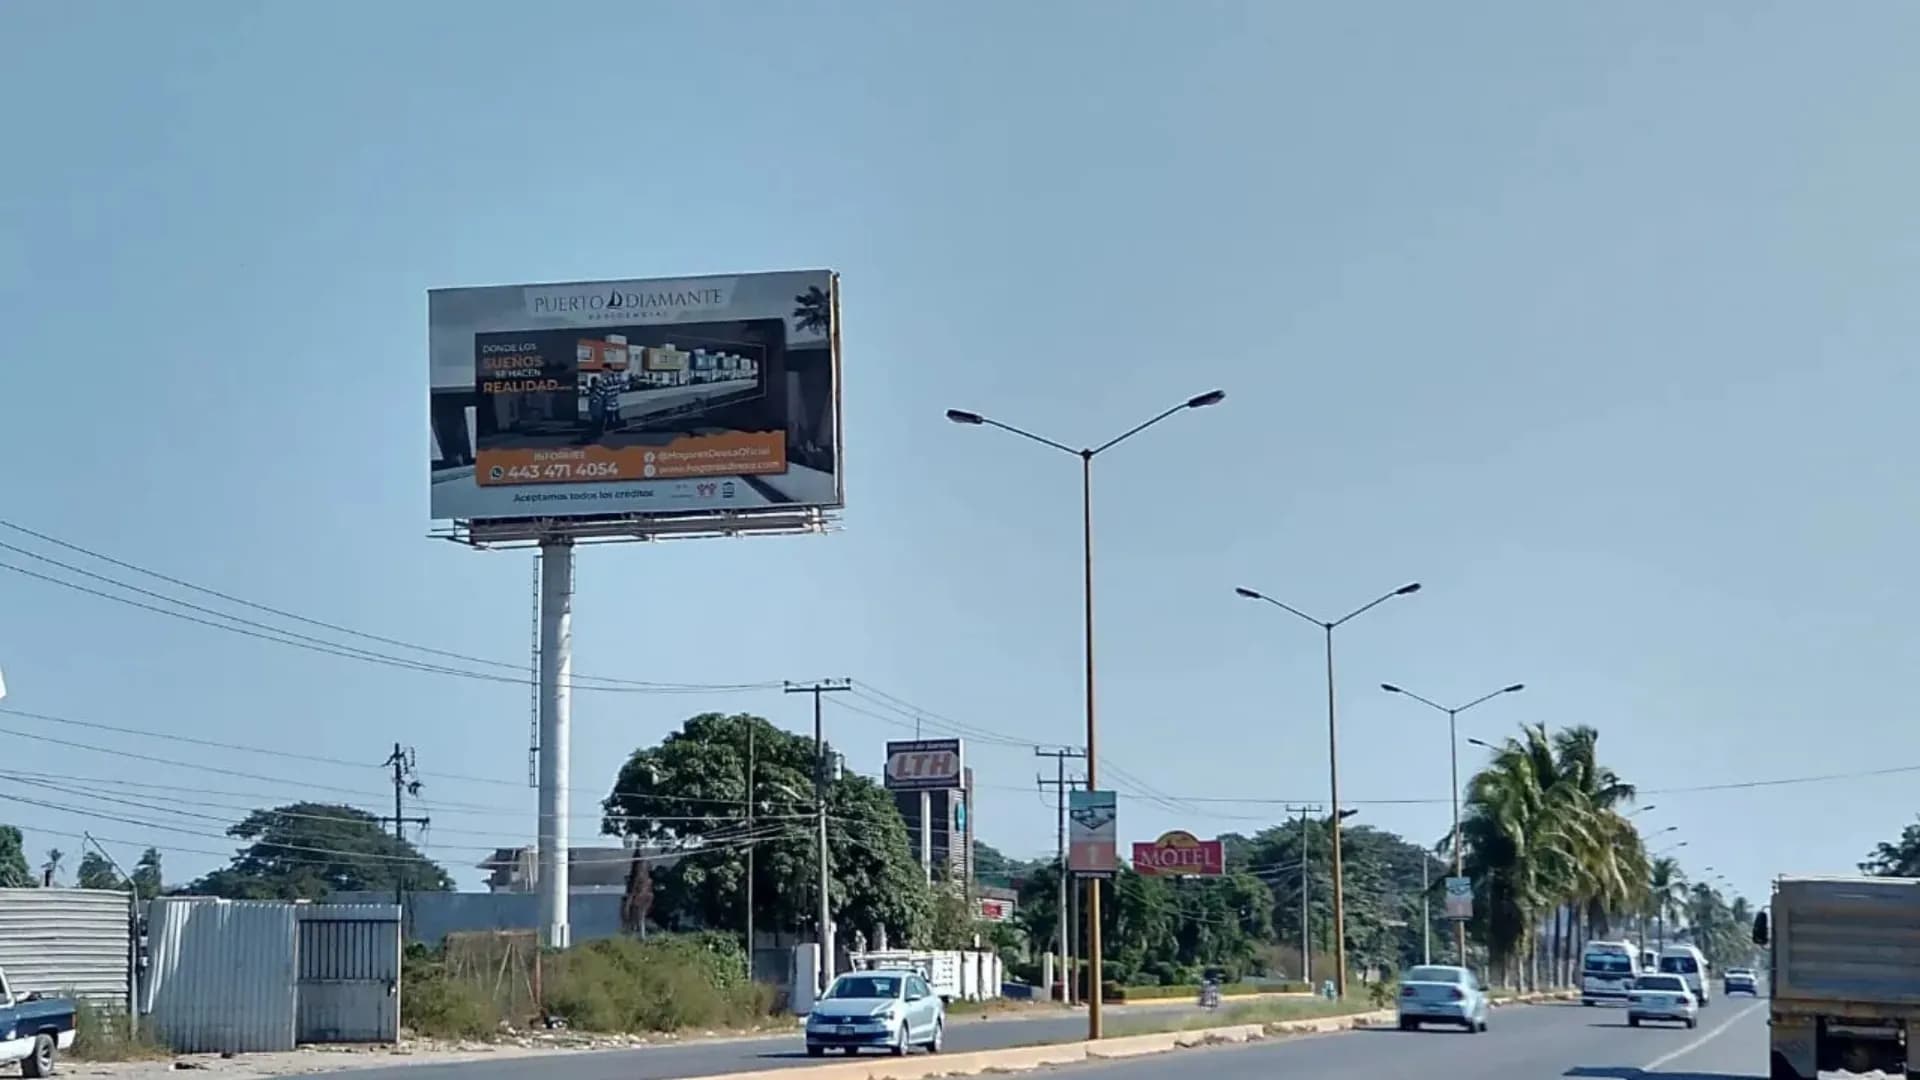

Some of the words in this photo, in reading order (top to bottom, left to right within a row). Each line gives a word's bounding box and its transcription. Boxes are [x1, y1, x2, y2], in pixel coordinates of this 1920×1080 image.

[535, 295, 604, 313] PUERTO
[625, 288, 722, 308] DIAMANTE
[482, 345, 517, 353] DONDE
[519, 343, 537, 352] LOS
[508, 369, 542, 378] HACEN
[508, 465, 540, 478] 443
[544, 464, 571, 478] 471
[576, 462, 618, 477] 4054
[513, 492, 568, 502] Aceptamos
[570, 491, 598, 500] todos
[600, 490, 613, 499] los
[896, 753, 952, 778] LTH
[1141, 847, 1215, 866] MOTEL
